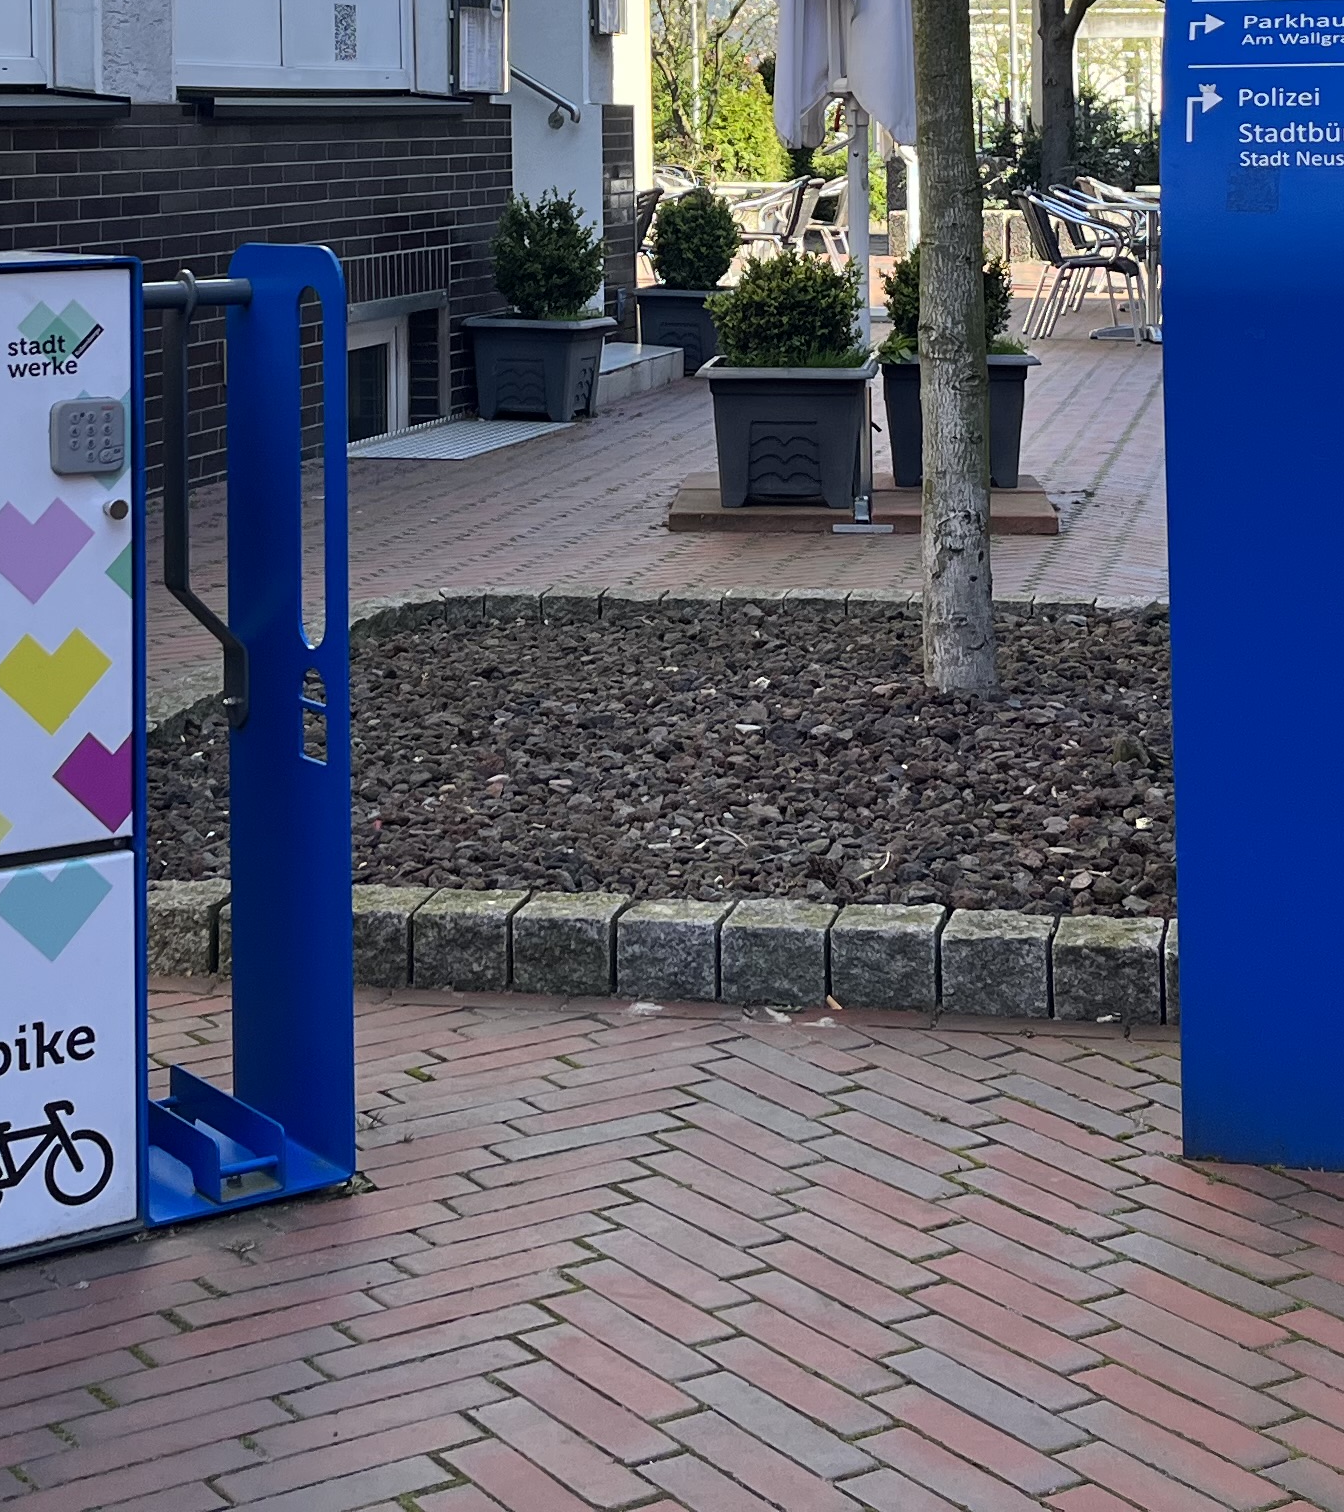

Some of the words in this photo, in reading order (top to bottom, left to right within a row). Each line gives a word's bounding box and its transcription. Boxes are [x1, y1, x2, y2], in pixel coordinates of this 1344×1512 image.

[1241, 33, 1274, 46] Am
[1238, 86, 1320, 107] Polizei
[1239, 150, 1290, 167] Stadt
[7, 334, 67, 357] stadt
[7, 356, 79, 379] werke
